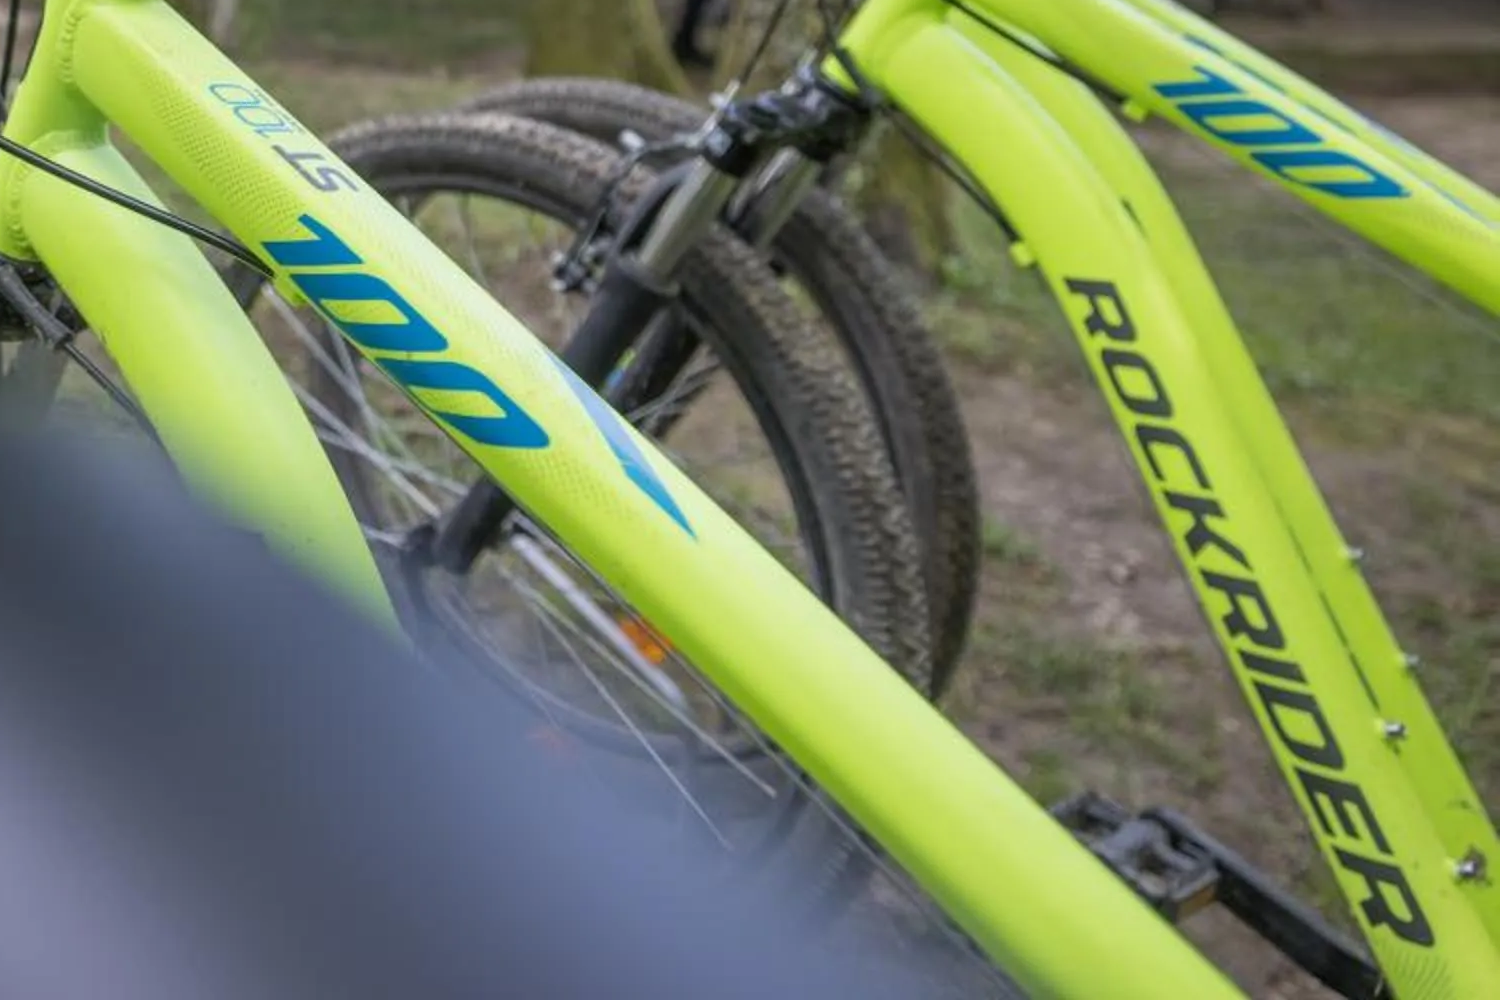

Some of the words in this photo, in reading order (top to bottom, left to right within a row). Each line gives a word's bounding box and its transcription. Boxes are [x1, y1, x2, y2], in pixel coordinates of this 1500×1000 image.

[1150, 66, 1412, 198] 100
[262, 213, 550, 449] 100
[1063, 276, 1435, 947] ROCKRIDER
